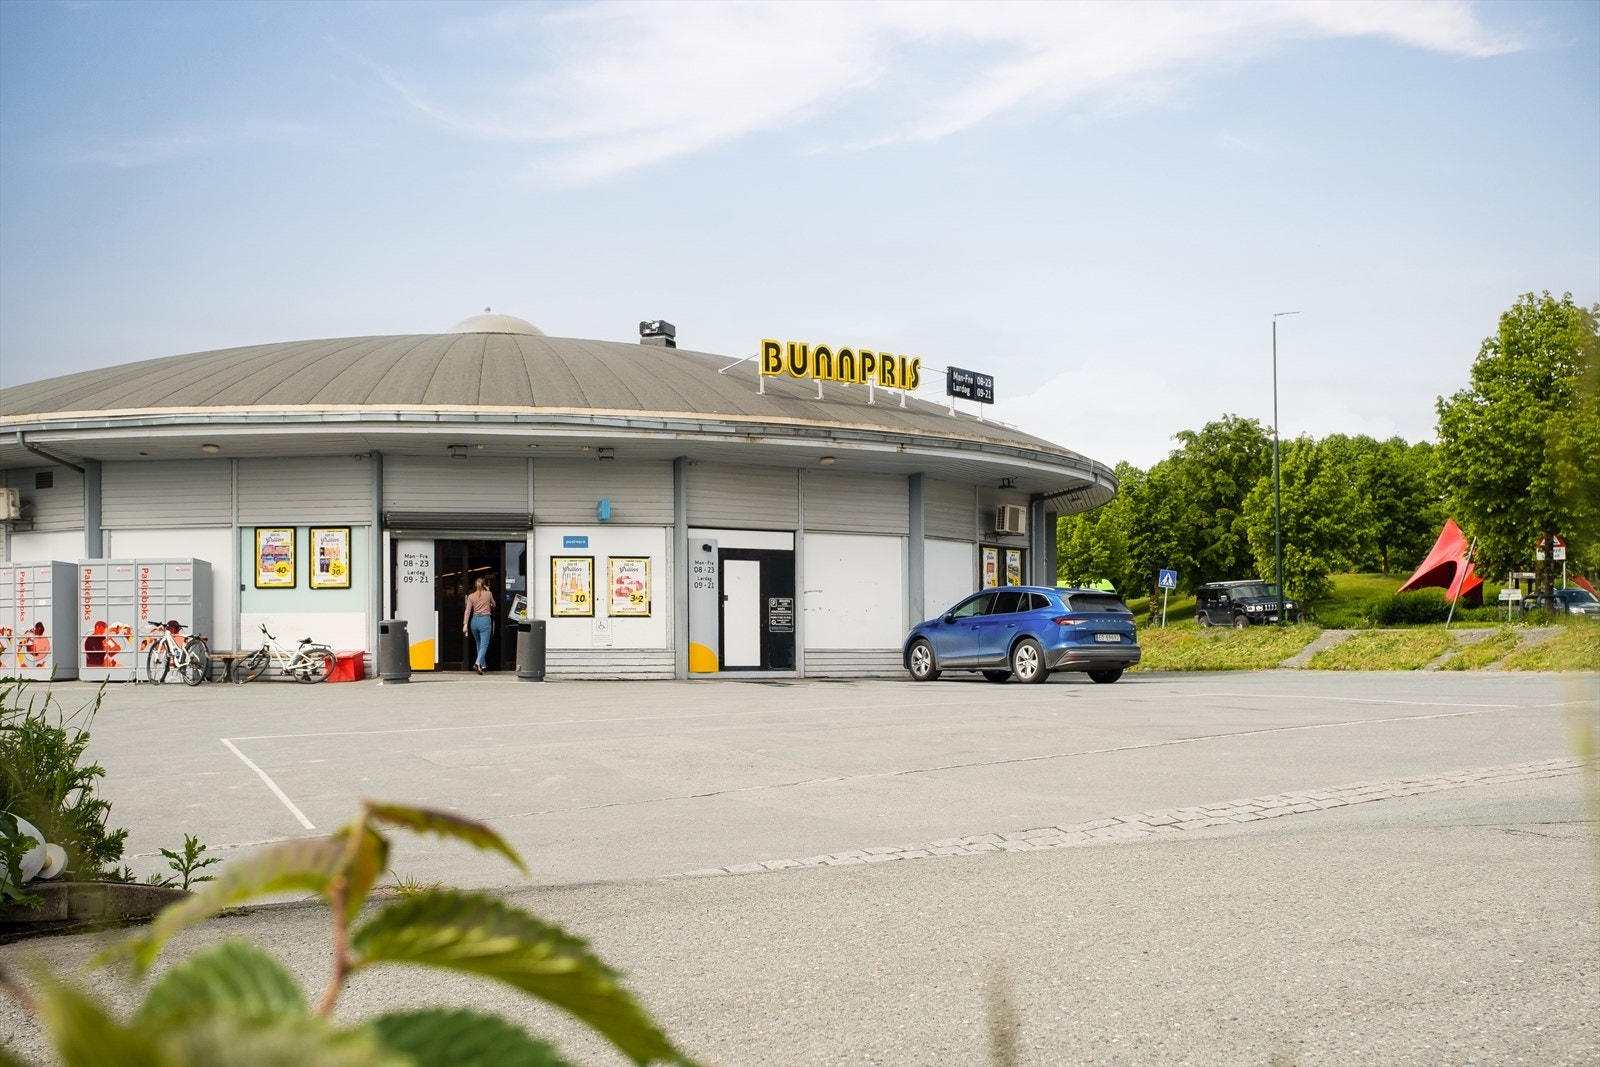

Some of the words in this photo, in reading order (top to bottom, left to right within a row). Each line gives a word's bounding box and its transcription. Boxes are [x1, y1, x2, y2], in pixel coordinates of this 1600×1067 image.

[761, 339, 921, 391] BUNNPRIS
[976, 376, 992, 388] 08-23
[976, 388, 992, 399] 09-21
[693, 566, 703, 574] 08
[707, 566, 715, 574] 23
[84, 568, 92, 621] Pakkeboks
[141, 567, 149, 620] Pakkeboks
